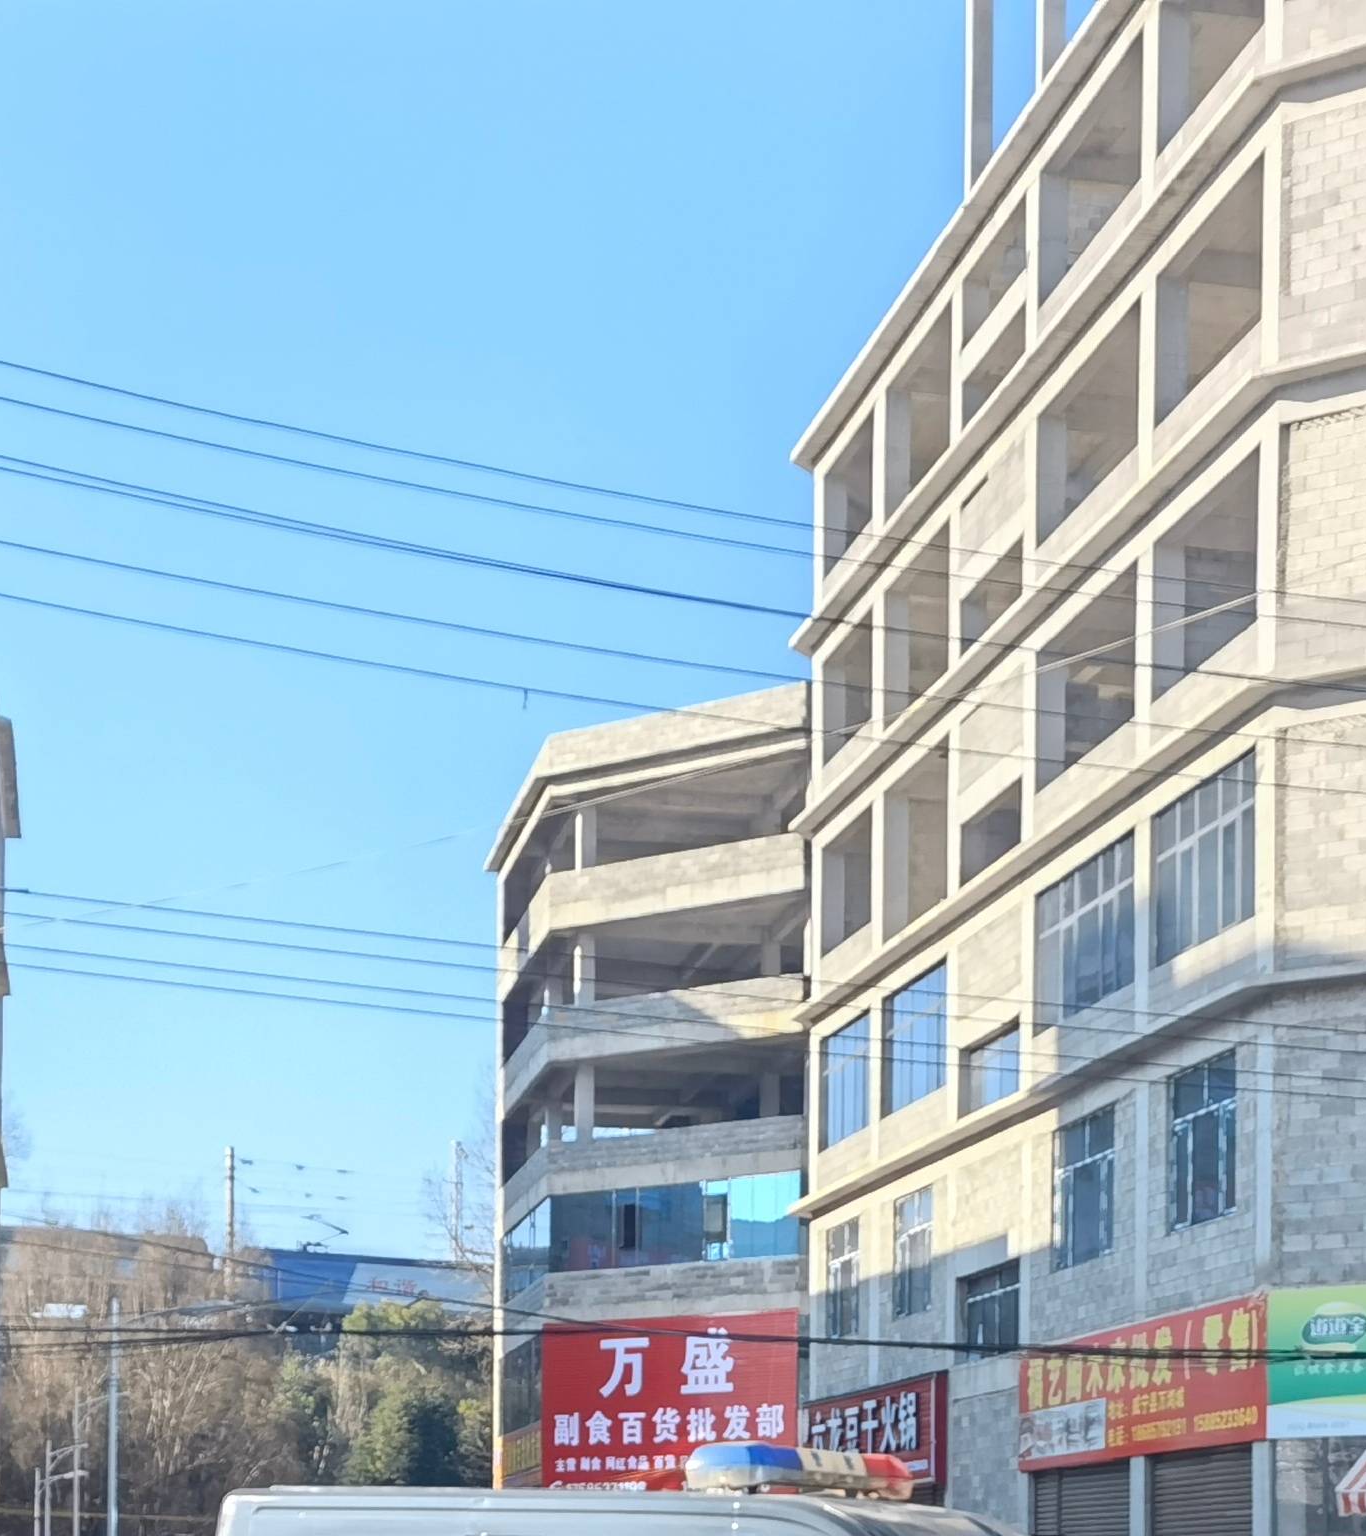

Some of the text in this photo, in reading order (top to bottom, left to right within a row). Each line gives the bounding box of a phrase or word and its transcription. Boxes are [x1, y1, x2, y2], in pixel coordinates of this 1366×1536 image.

[598, 1327, 735, 1399] 万盛
[553, 1403, 786, 1447] 副食百货批发部
